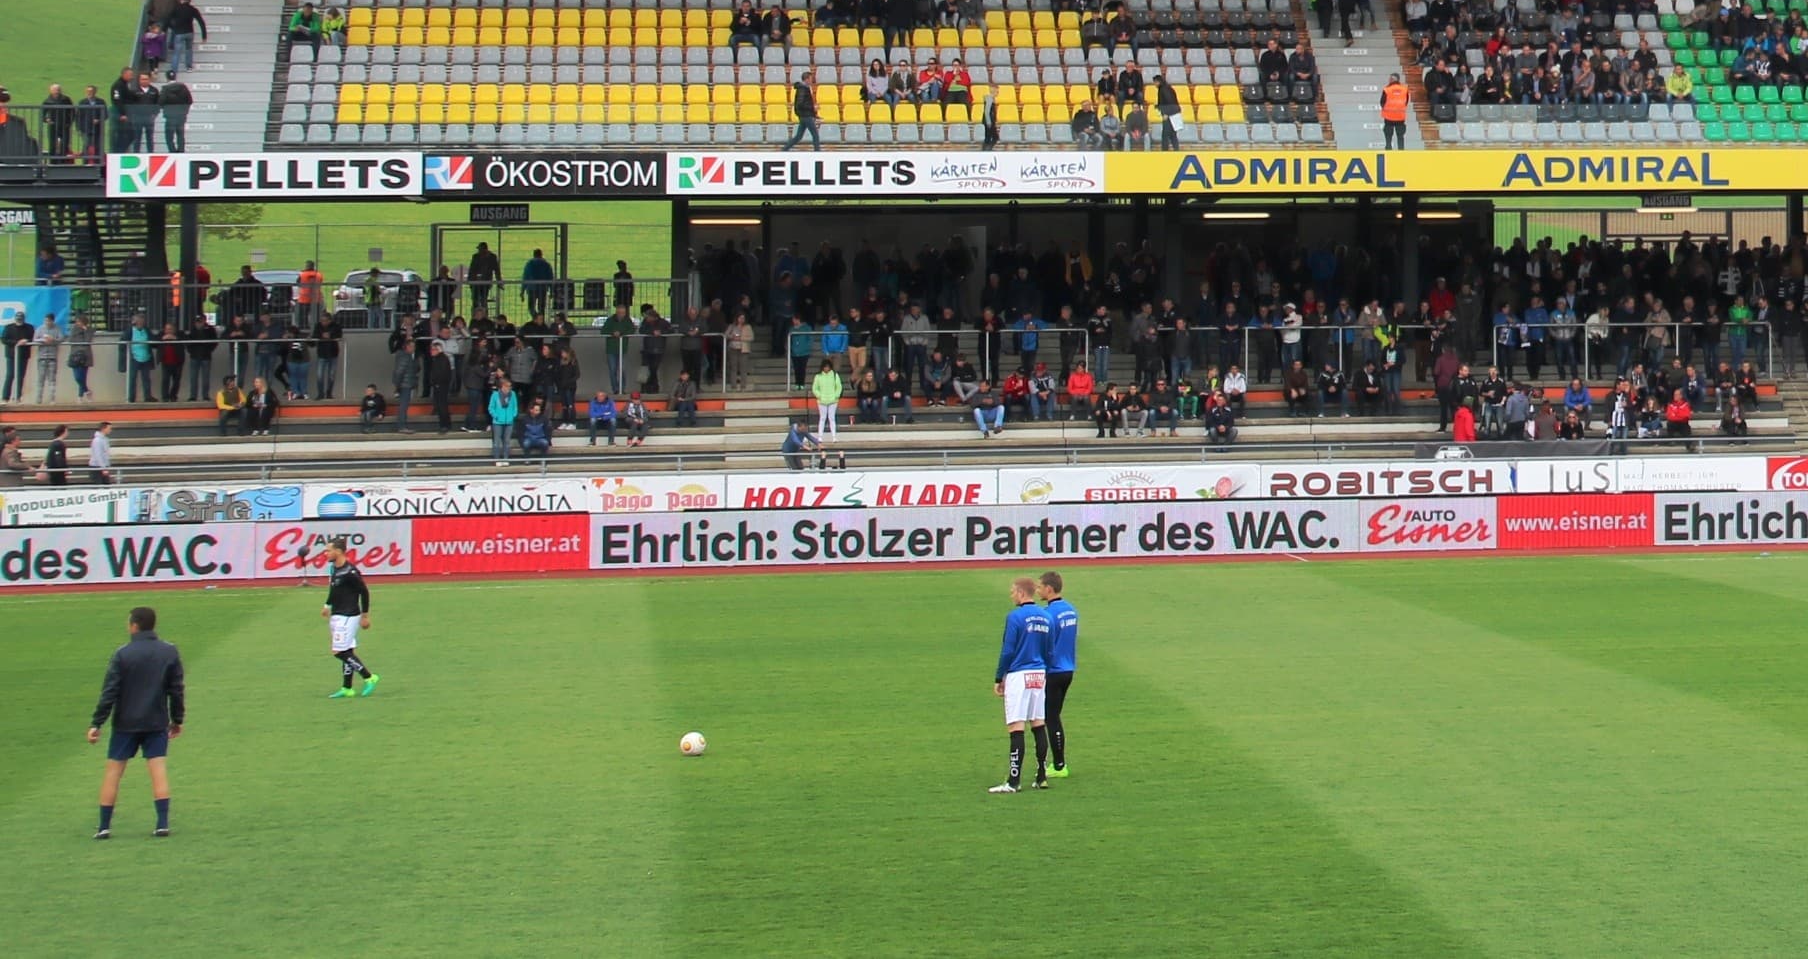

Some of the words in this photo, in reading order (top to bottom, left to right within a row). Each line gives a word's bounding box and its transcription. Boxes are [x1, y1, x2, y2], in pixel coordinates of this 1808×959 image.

[188, 158, 411, 190] PELLETS
[485, 156, 657, 187] ÖKOSTROM
[733, 159, 917, 187] PELLETS
[1170, 153, 1405, 189] ADMIRAL
[1500, 153, 1730, 187] ADMIRAL
[957, 178, 996, 189] SPORT
[1046, 178, 1084, 189] SPORT
[472, 206, 528, 220] AUSGANG
[1090, 488, 1172, 501] SORGER
[1269, 468, 1493, 497] ROBITSCH
[7, 495, 85, 515] MODULBAU
[88, 490, 129, 504] GmbH
[366, 496, 460, 515] KONICA
[466, 493, 572, 514] MINOLTA
[600, 491, 653, 512] pago
[743, 486, 834, 509] HOLZ
[876, 483, 982, 506] KLADE
[1366, 503, 1492, 545] Eisner
[1410, 509, 1456, 522] AUTO
[1505, 510, 1648, 533] www.eisner.at
[420, 533, 581, 556] www.eisner.at
[601, 519, 779, 564] Ehrlich:
[791, 516, 954, 560] Stolzer
[966, 515, 1127, 556] Partner
[1138, 511, 1215, 553] des
[1226, 509, 1340, 550] WAC.
[1, 537, 89, 581] des
[103, 533, 233, 579] WAC.
[1010, 748, 1019, 777] OPEL
